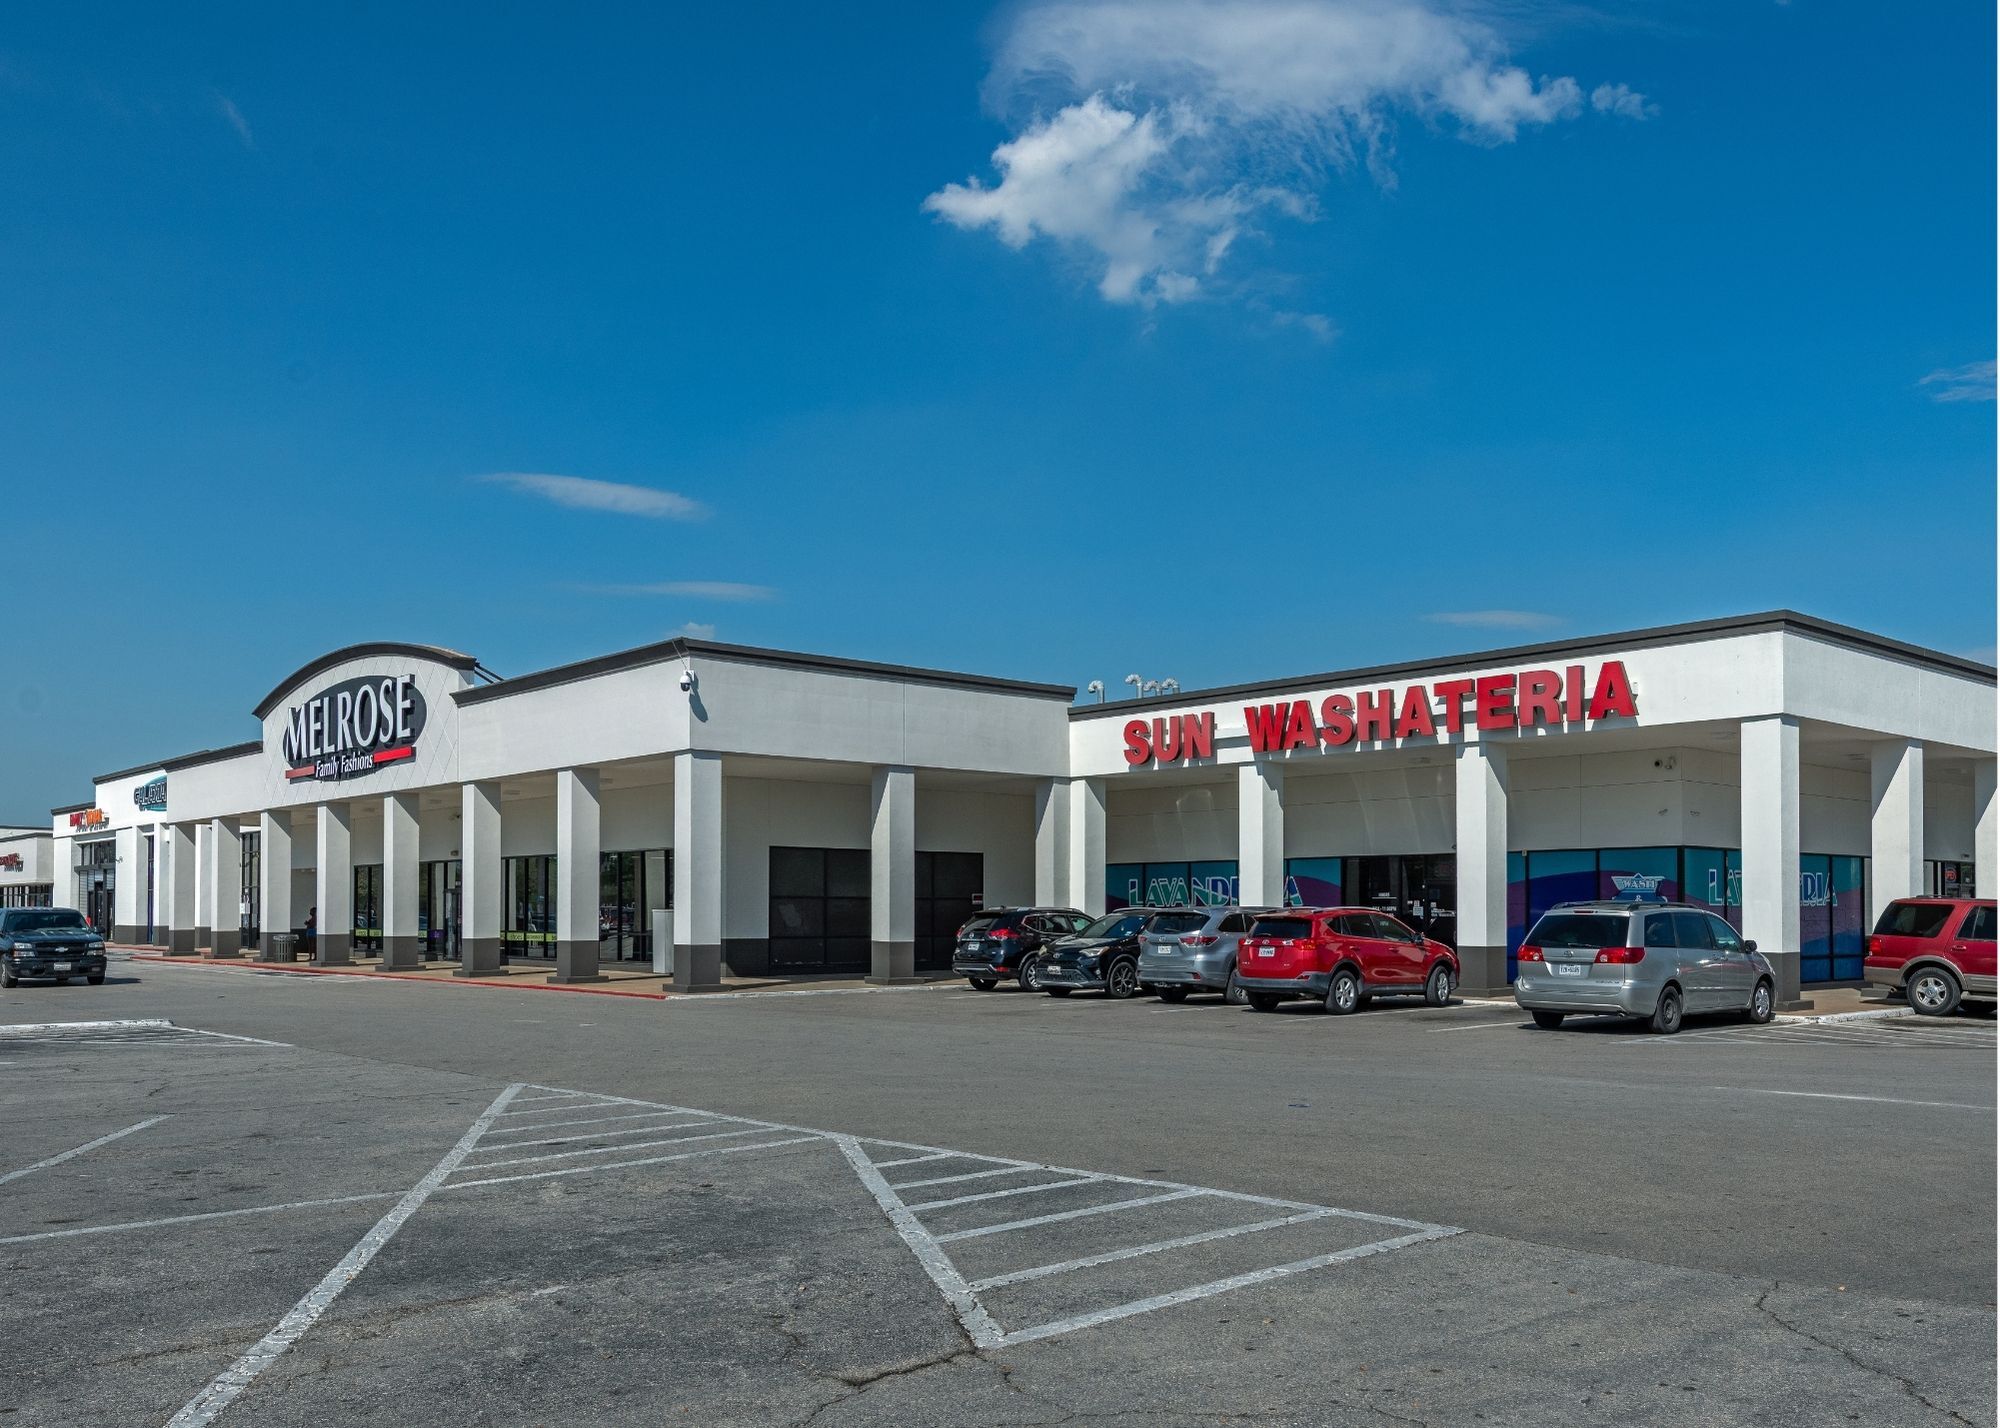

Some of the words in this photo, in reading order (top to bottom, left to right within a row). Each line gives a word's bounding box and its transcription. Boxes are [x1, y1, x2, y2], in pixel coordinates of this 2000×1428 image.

[285, 673, 412, 761] MELROSE
[1123, 712, 1214, 765] SUN
[1244, 660, 1638, 753] WASHATERIA
[315, 755, 340, 779] Family
[341, 753, 374, 774] Fashions
[1623, 879, 1655, 889] WASH
